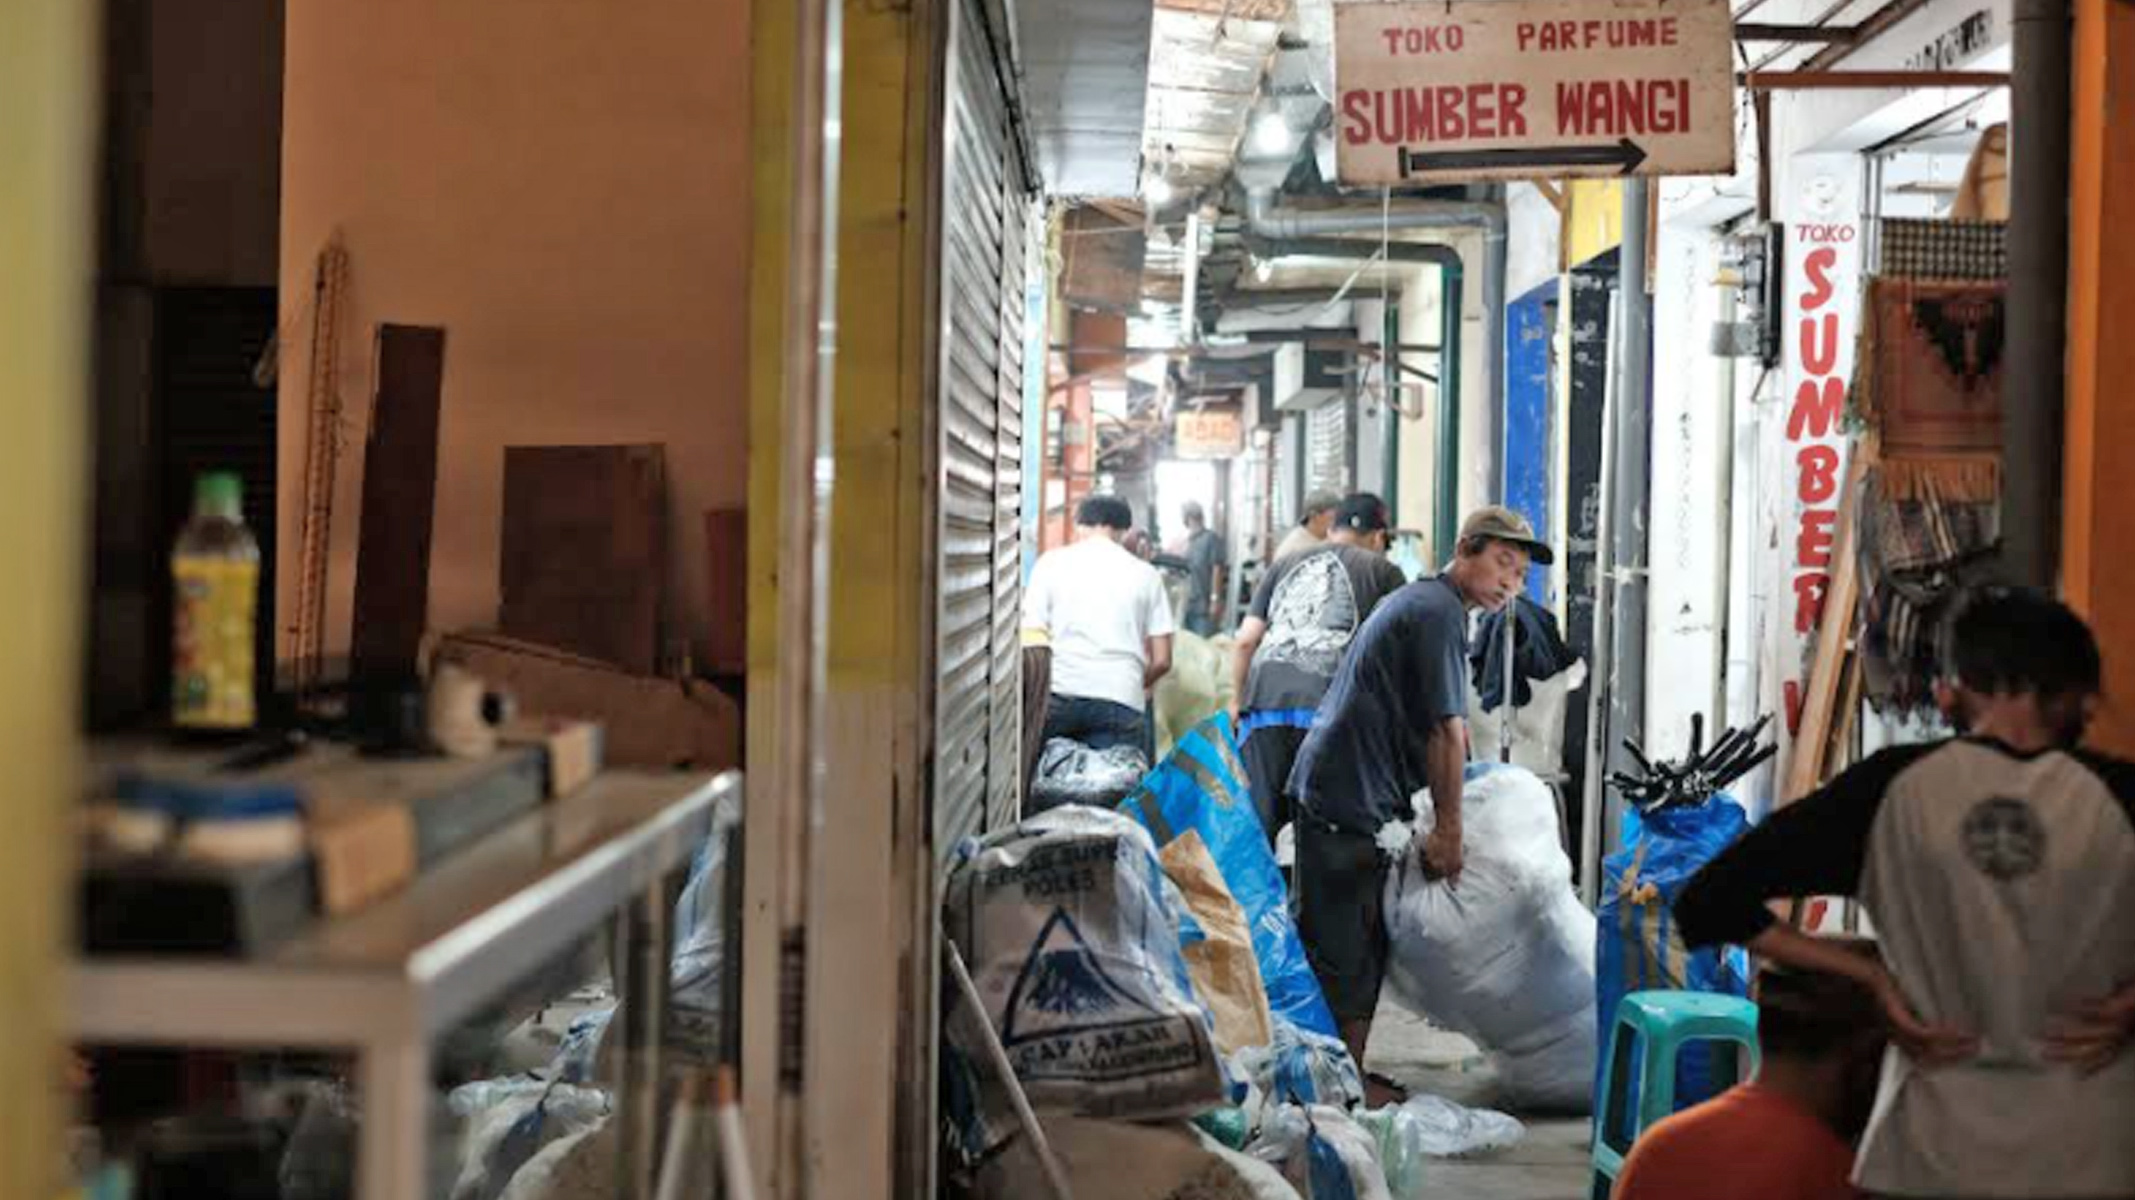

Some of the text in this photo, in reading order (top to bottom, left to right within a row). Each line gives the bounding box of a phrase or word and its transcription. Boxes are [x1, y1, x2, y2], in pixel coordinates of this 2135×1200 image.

[1382, 17, 1679, 55] TOKO PARFUME
[1342, 78, 1691, 147] SUMBER WANGI
[1796, 224, 1856, 243] TOKO
[1786, 247, 1845, 634] SUMBER
